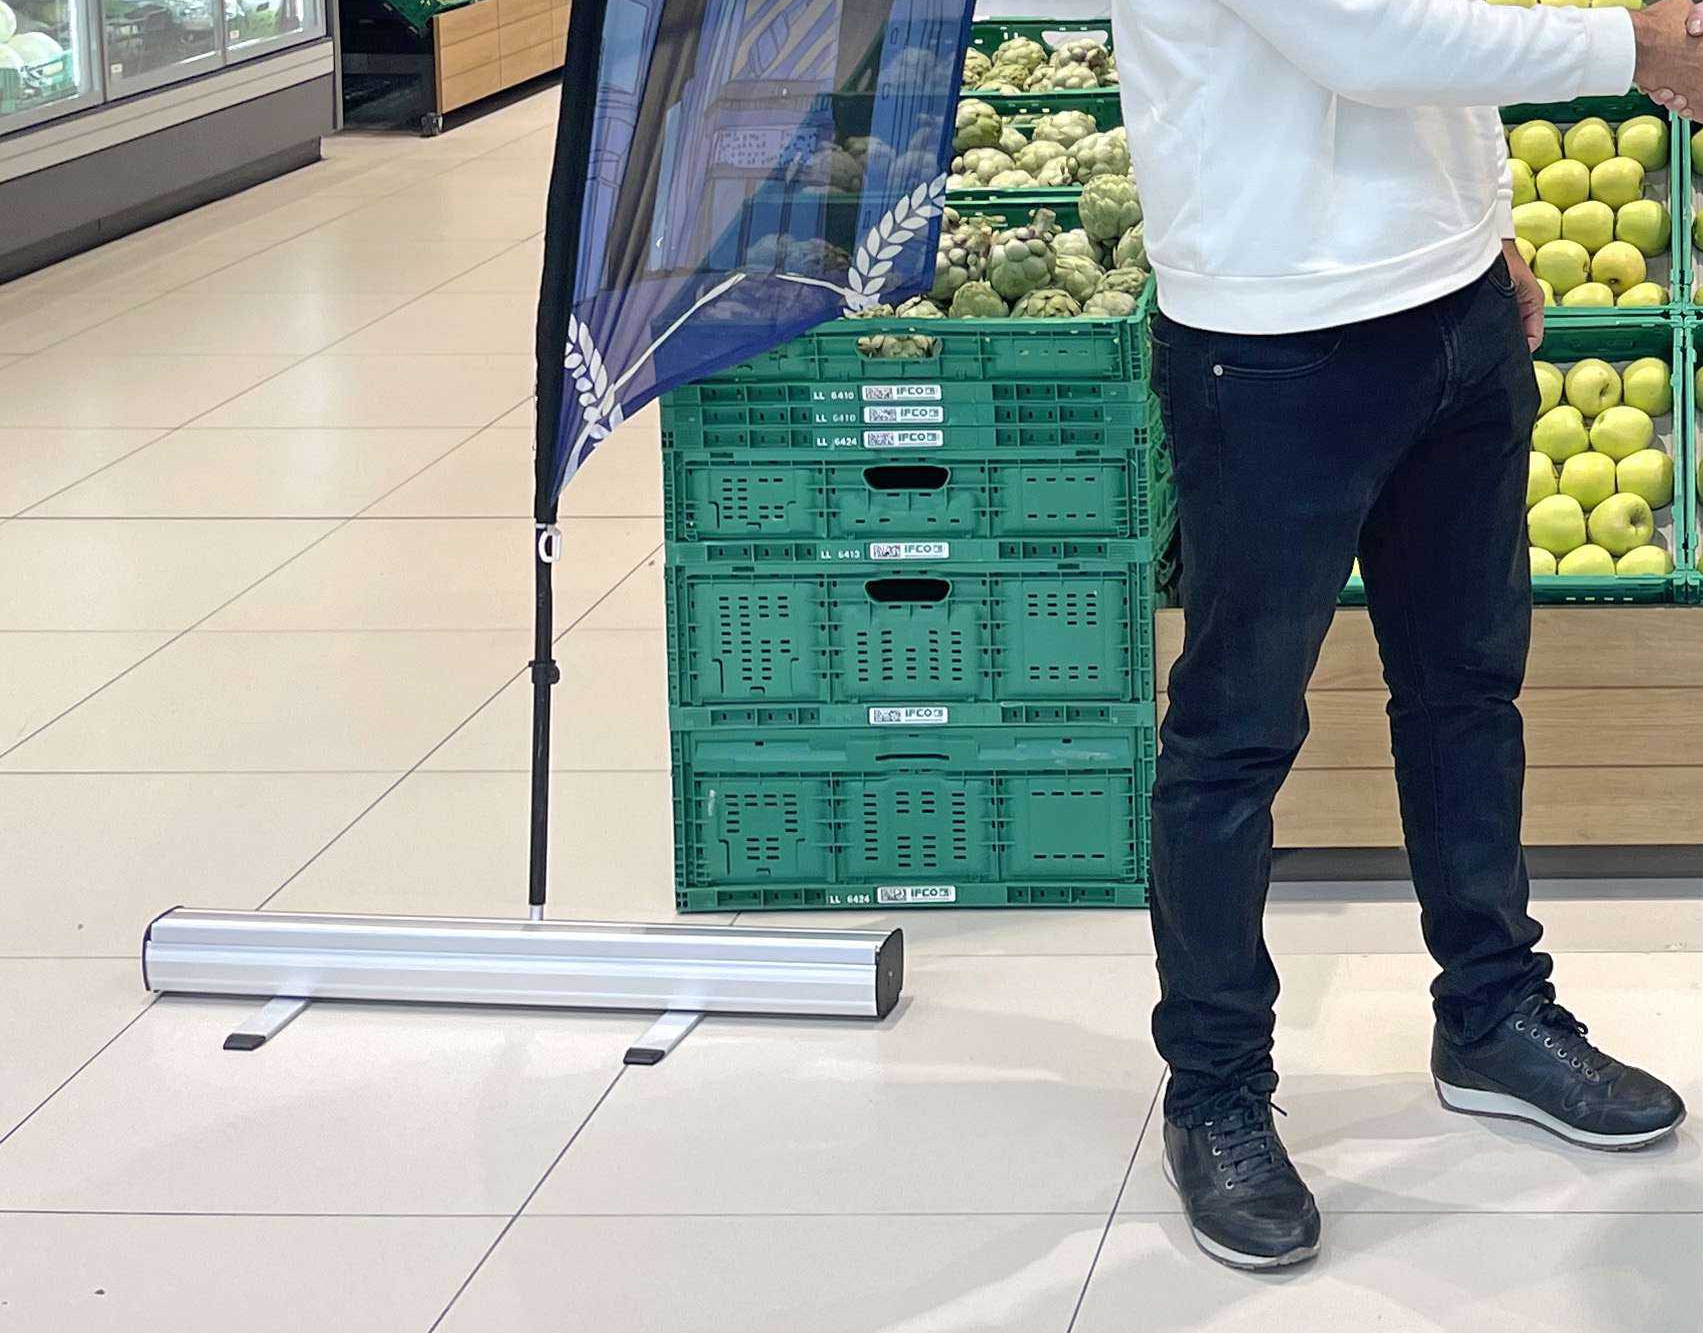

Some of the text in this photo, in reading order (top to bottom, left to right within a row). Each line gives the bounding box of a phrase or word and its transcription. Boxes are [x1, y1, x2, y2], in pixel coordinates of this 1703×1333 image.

[813, 387, 924, 400] LL 6410 IFCO
[816, 413, 828, 423] LL
[900, 409, 928, 418] IFCO
[816, 433, 926, 446] LL 6424 IFCO
[820, 550, 832, 559] LL
[904, 545, 932, 554] IFCO
[904, 709, 933, 718] IFCO
[830, 888, 938, 904] LL 6424 IFCO
